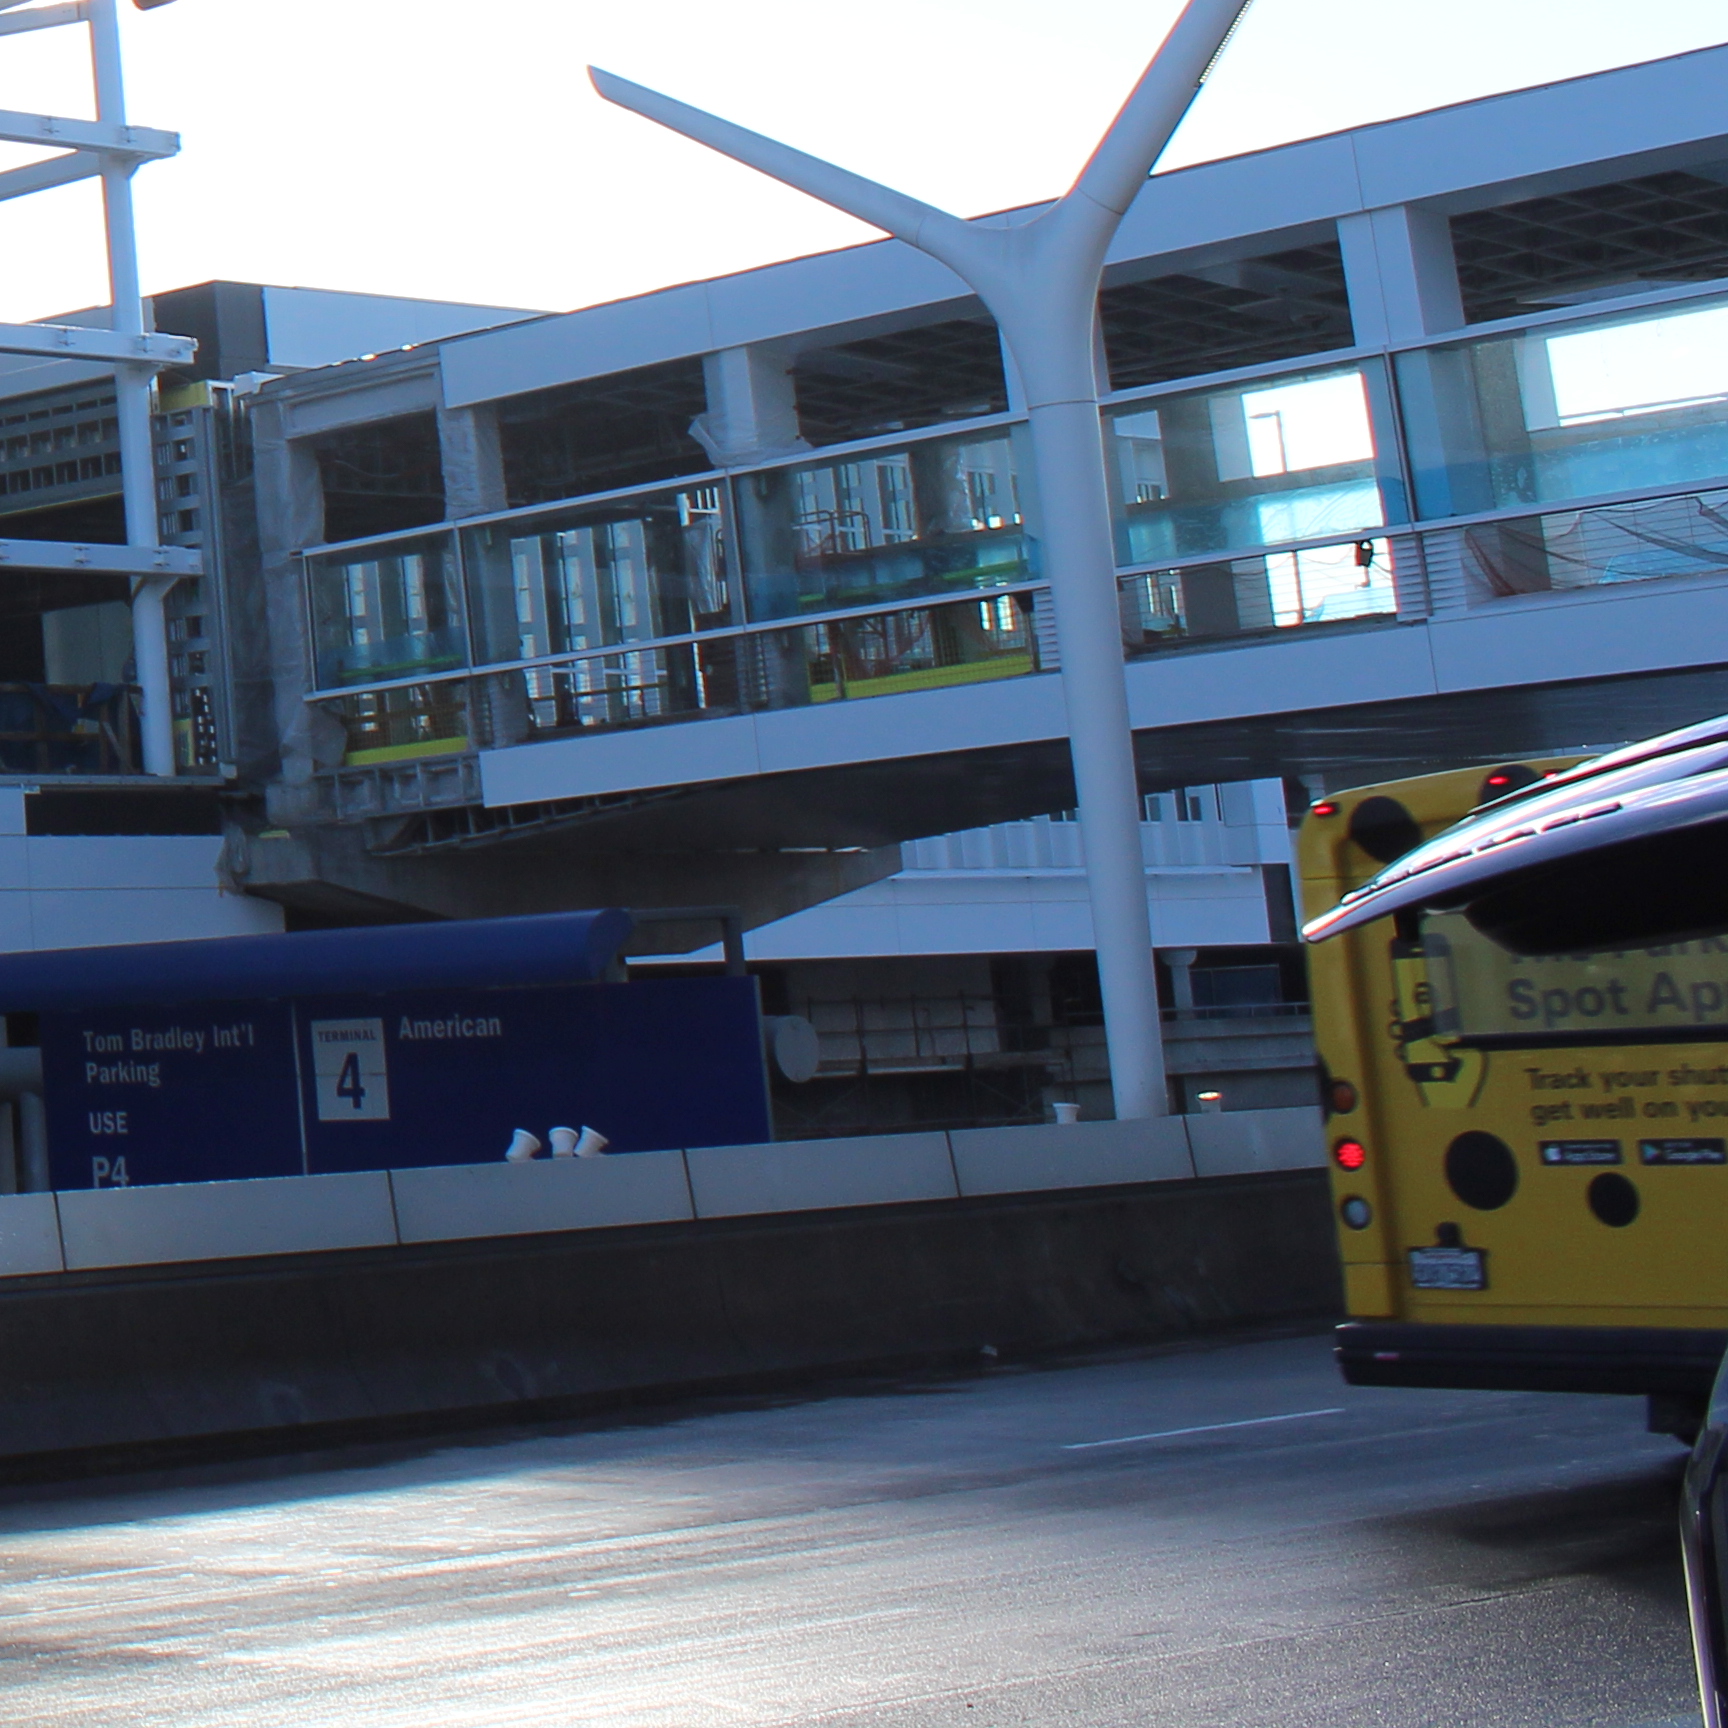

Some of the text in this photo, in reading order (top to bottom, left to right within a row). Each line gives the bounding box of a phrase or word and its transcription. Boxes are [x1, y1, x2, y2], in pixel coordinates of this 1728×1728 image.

[1508, 971, 1728, 1027] Spot Ap
[83, 1022, 255, 1053] Tom Bradley Int'l
[318, 1028, 376, 1042] TERMINAL
[399, 1014, 502, 1039] American
[85, 1059, 161, 1087] Parking
[337, 1052, 365, 1109] 4
[1525, 1067, 1591, 1090] Track
[1600, 1070, 1659, 1093] your
[89, 1112, 129, 1134] USE
[1531, 1101, 1573, 1126] get
[1581, 1097, 1636, 1119] well
[1643, 1101, 1679, 1117] on
[91, 1155, 130, 1188] P4
